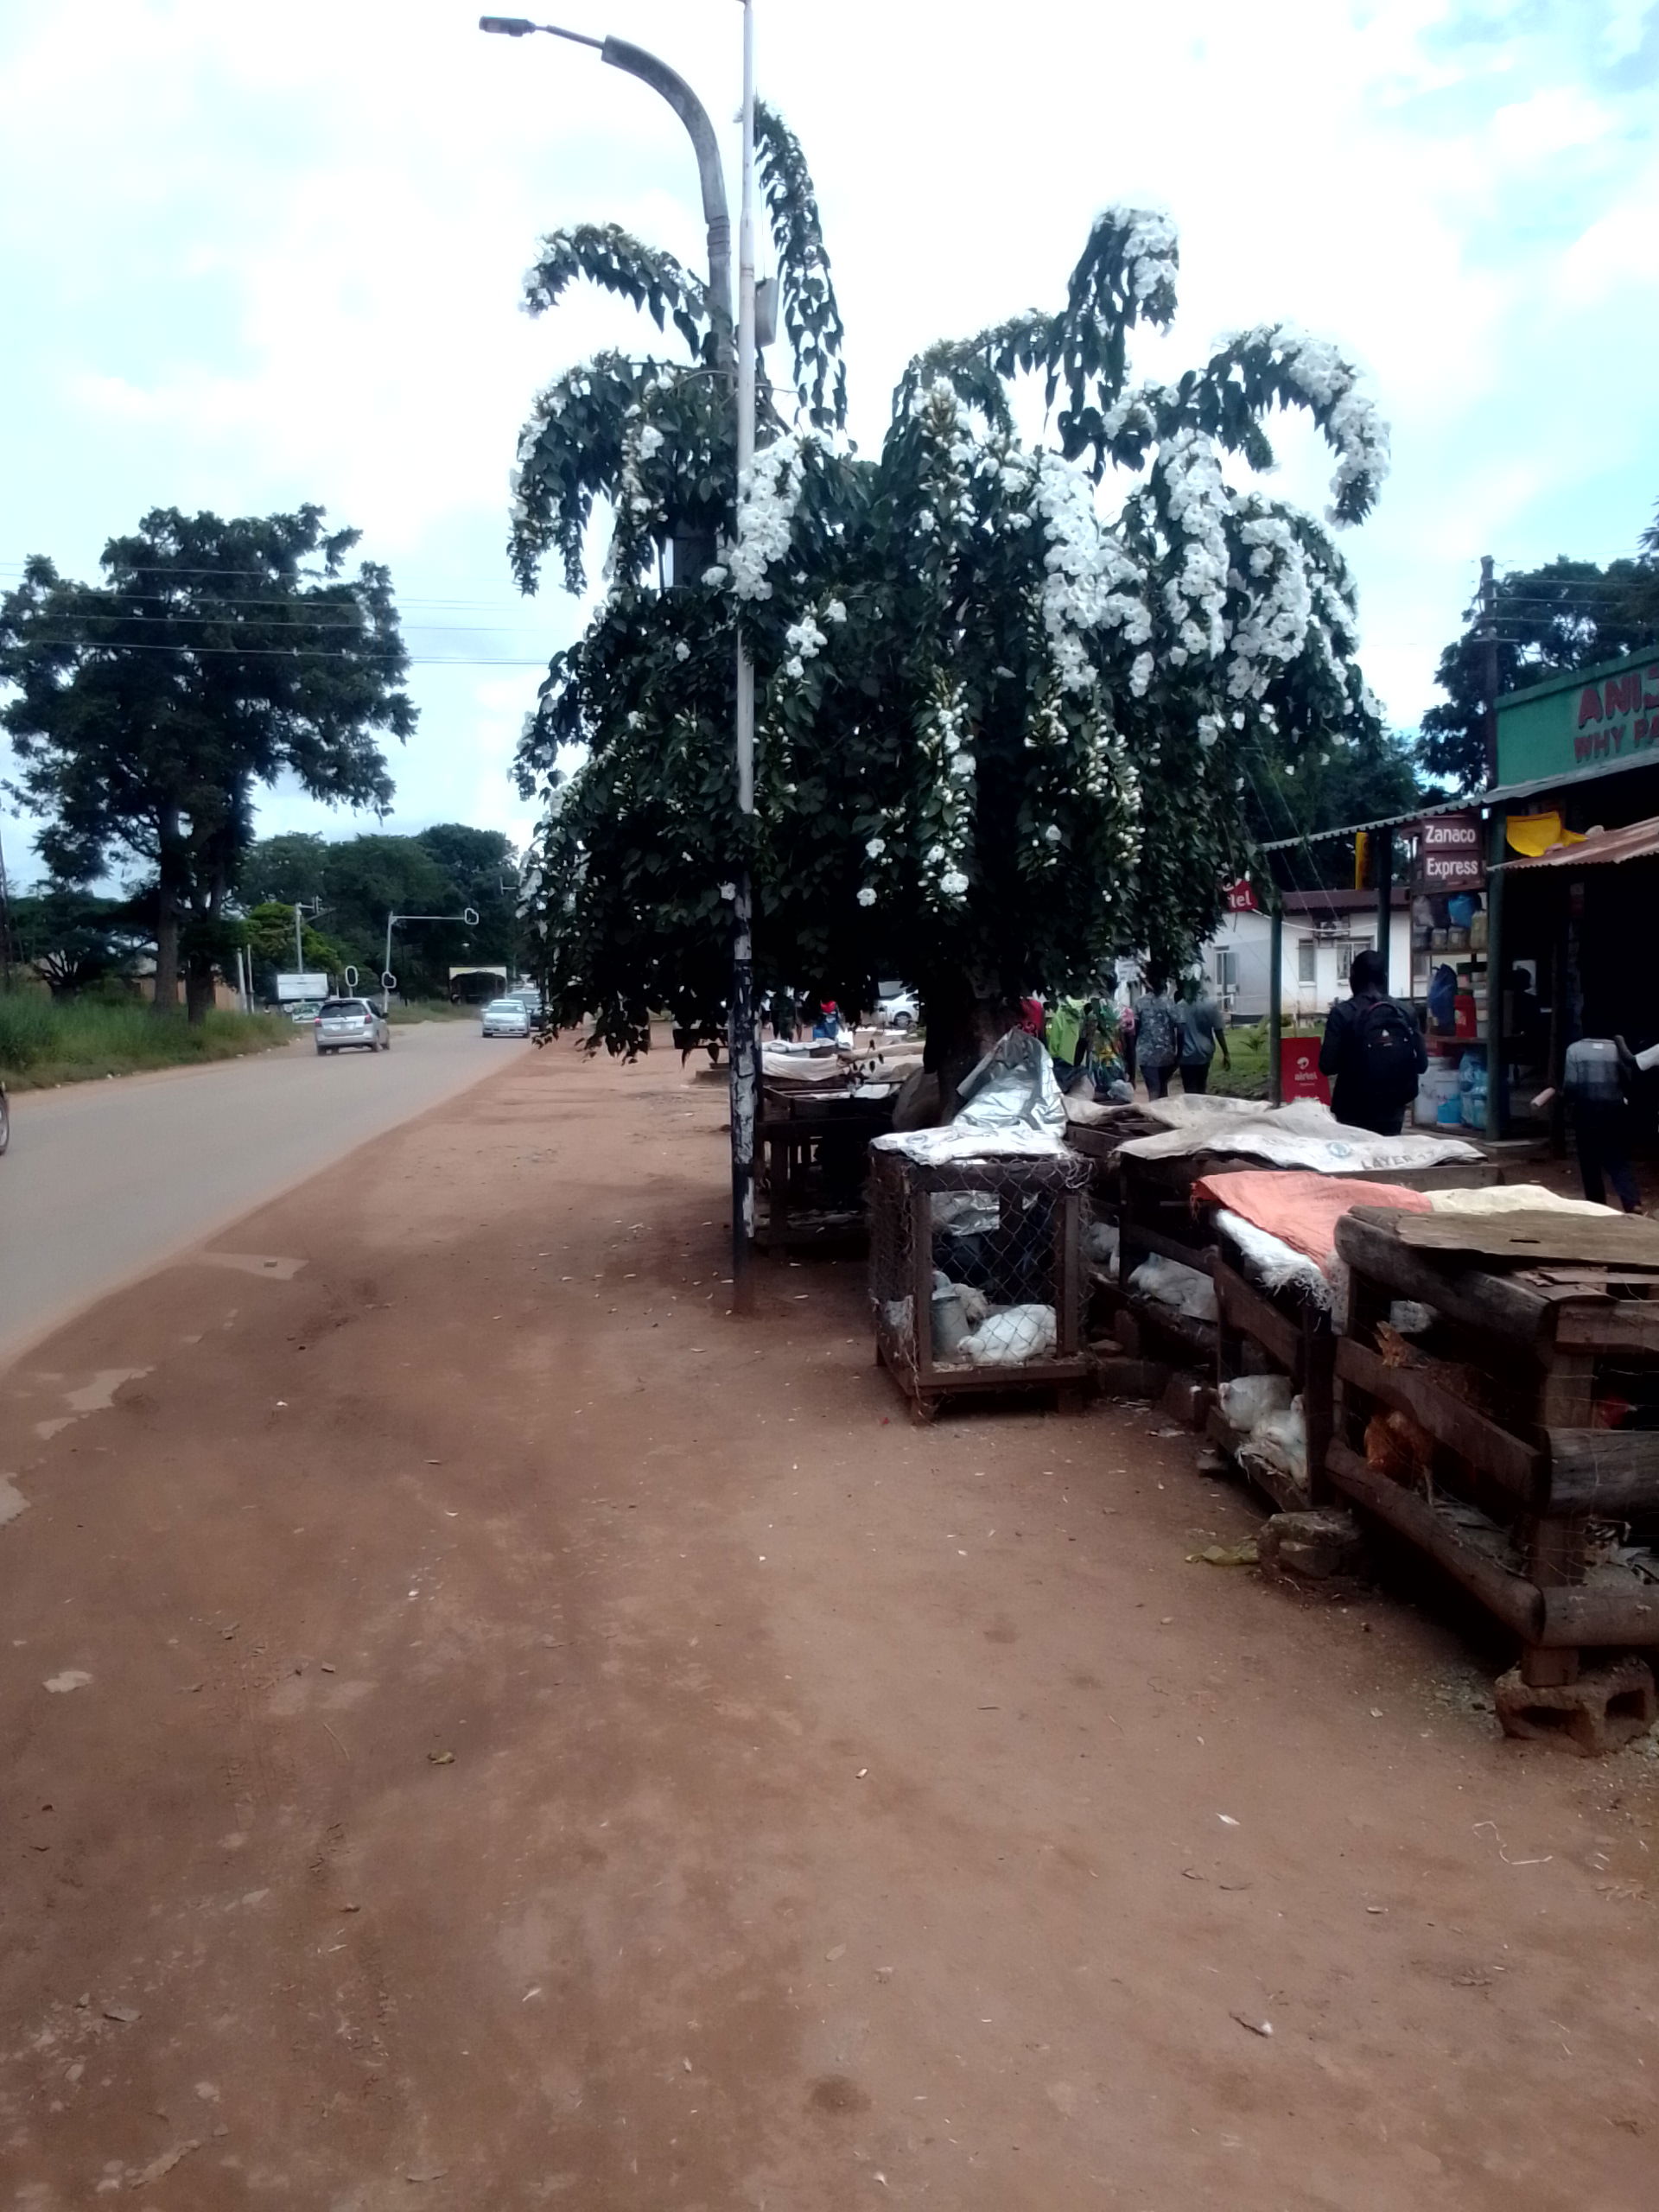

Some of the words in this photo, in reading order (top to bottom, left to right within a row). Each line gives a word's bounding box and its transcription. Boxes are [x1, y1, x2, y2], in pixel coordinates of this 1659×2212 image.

[1573, 723, 1626, 763] WHY
[1425, 824, 1476, 843] Zanaco
[1427, 857, 1478, 880] Express
